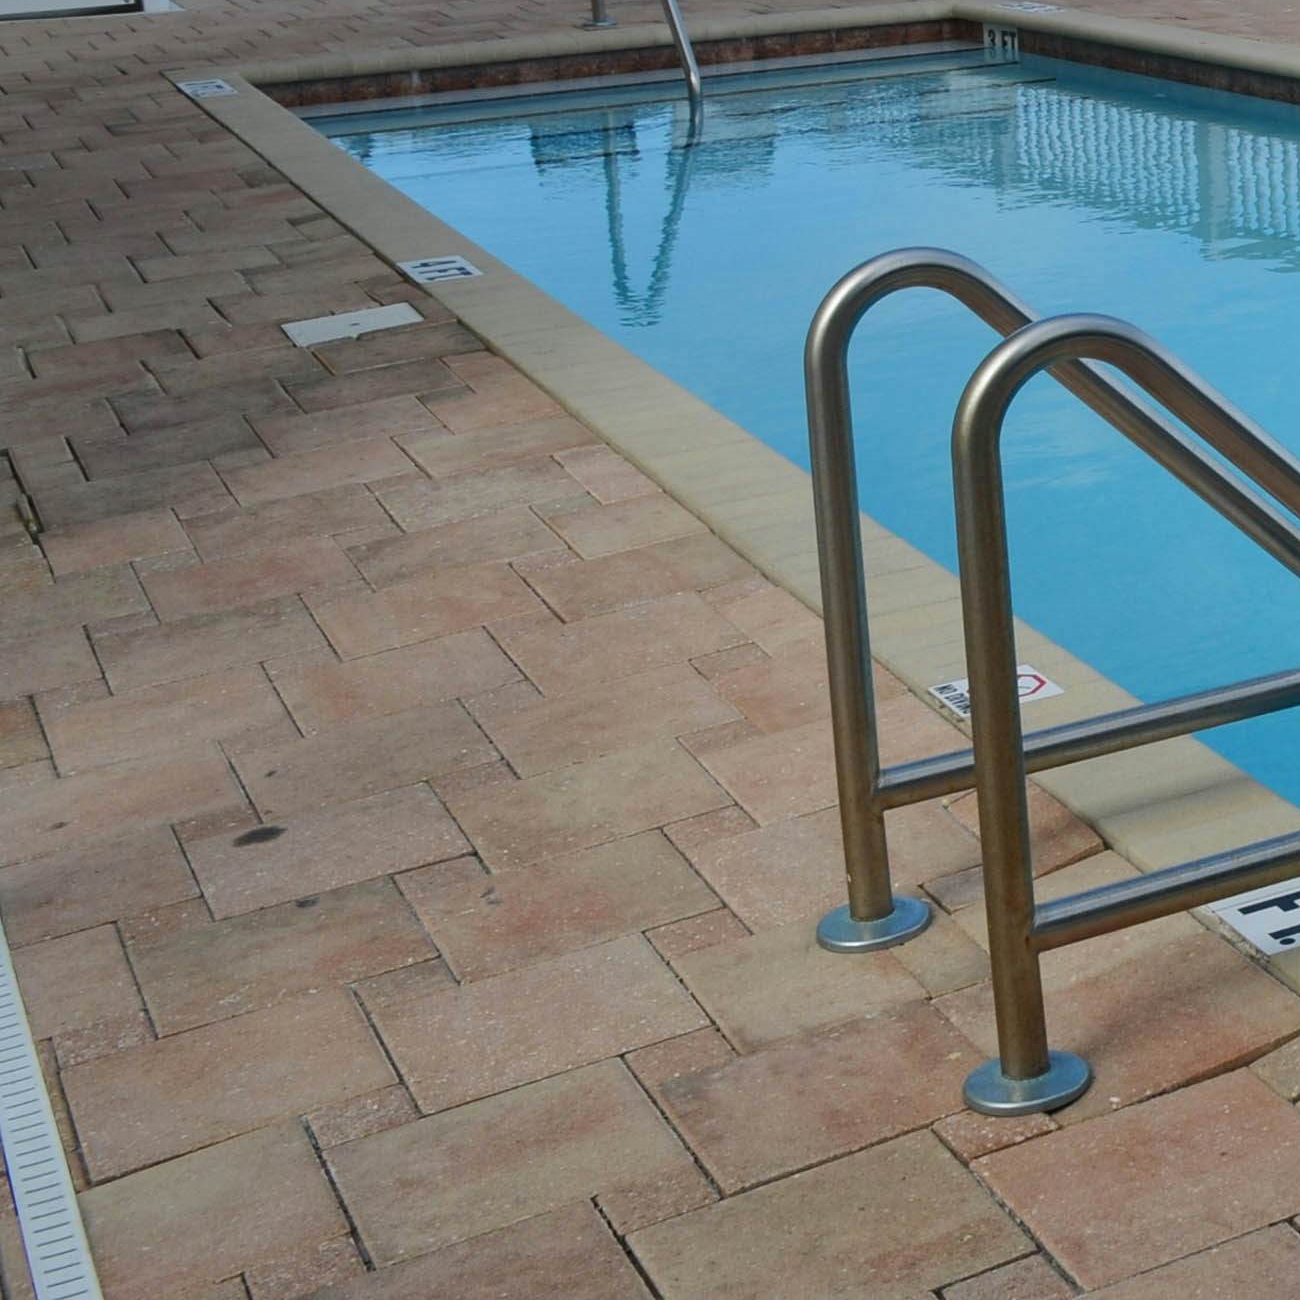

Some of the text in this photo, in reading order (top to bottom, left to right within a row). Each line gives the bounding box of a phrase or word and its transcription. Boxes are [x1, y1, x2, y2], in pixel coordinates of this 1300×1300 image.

[988, 29, 1017, 49] 3 FT
[934, 683, 958, 695] NO
